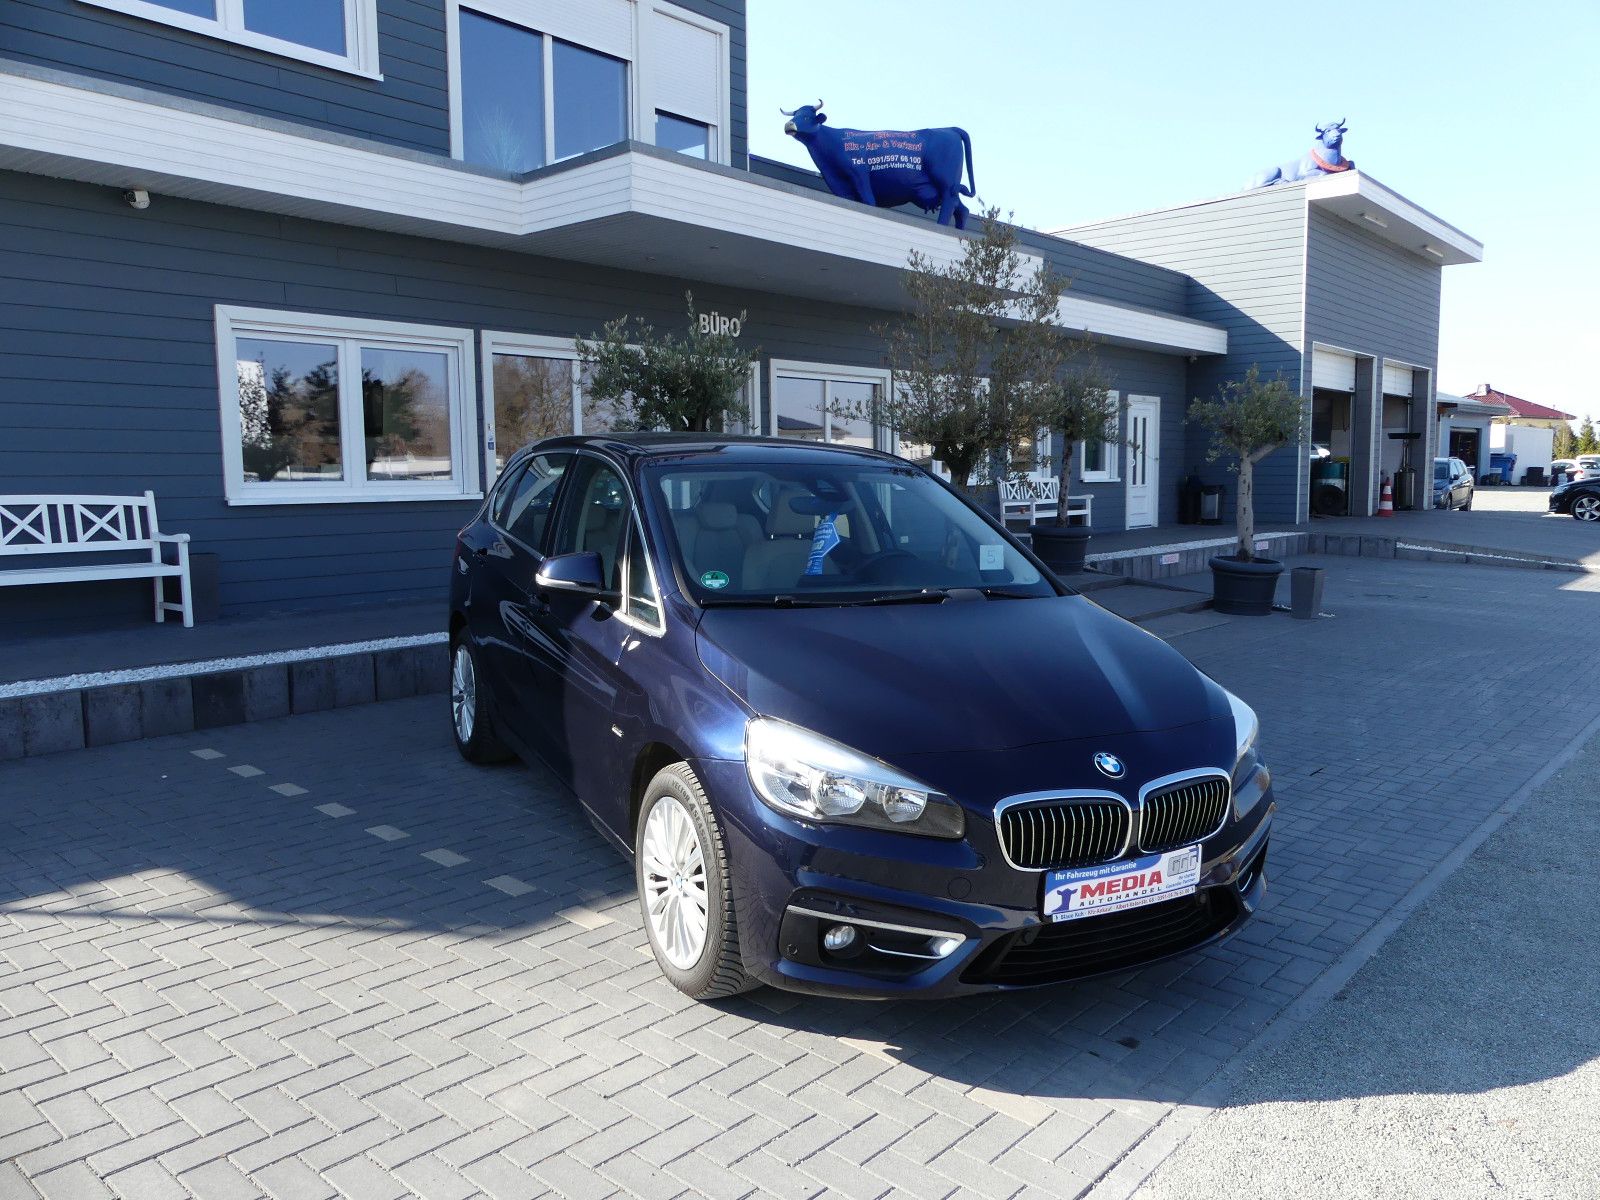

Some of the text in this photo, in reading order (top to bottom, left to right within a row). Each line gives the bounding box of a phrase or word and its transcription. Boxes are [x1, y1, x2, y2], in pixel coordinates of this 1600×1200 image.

[851, 157, 866, 165] Tel.
[867, 155, 899, 165] 0391/597
[910, 156, 922, 165] 100
[699, 312, 740, 337] BÜRO
[1055, 862, 1137, 881] Ihr Fahrzeug mit Garantie
[1080, 870, 1163, 900] MEDIA
[1080, 886, 1162, 907] AUTOHANDEL
